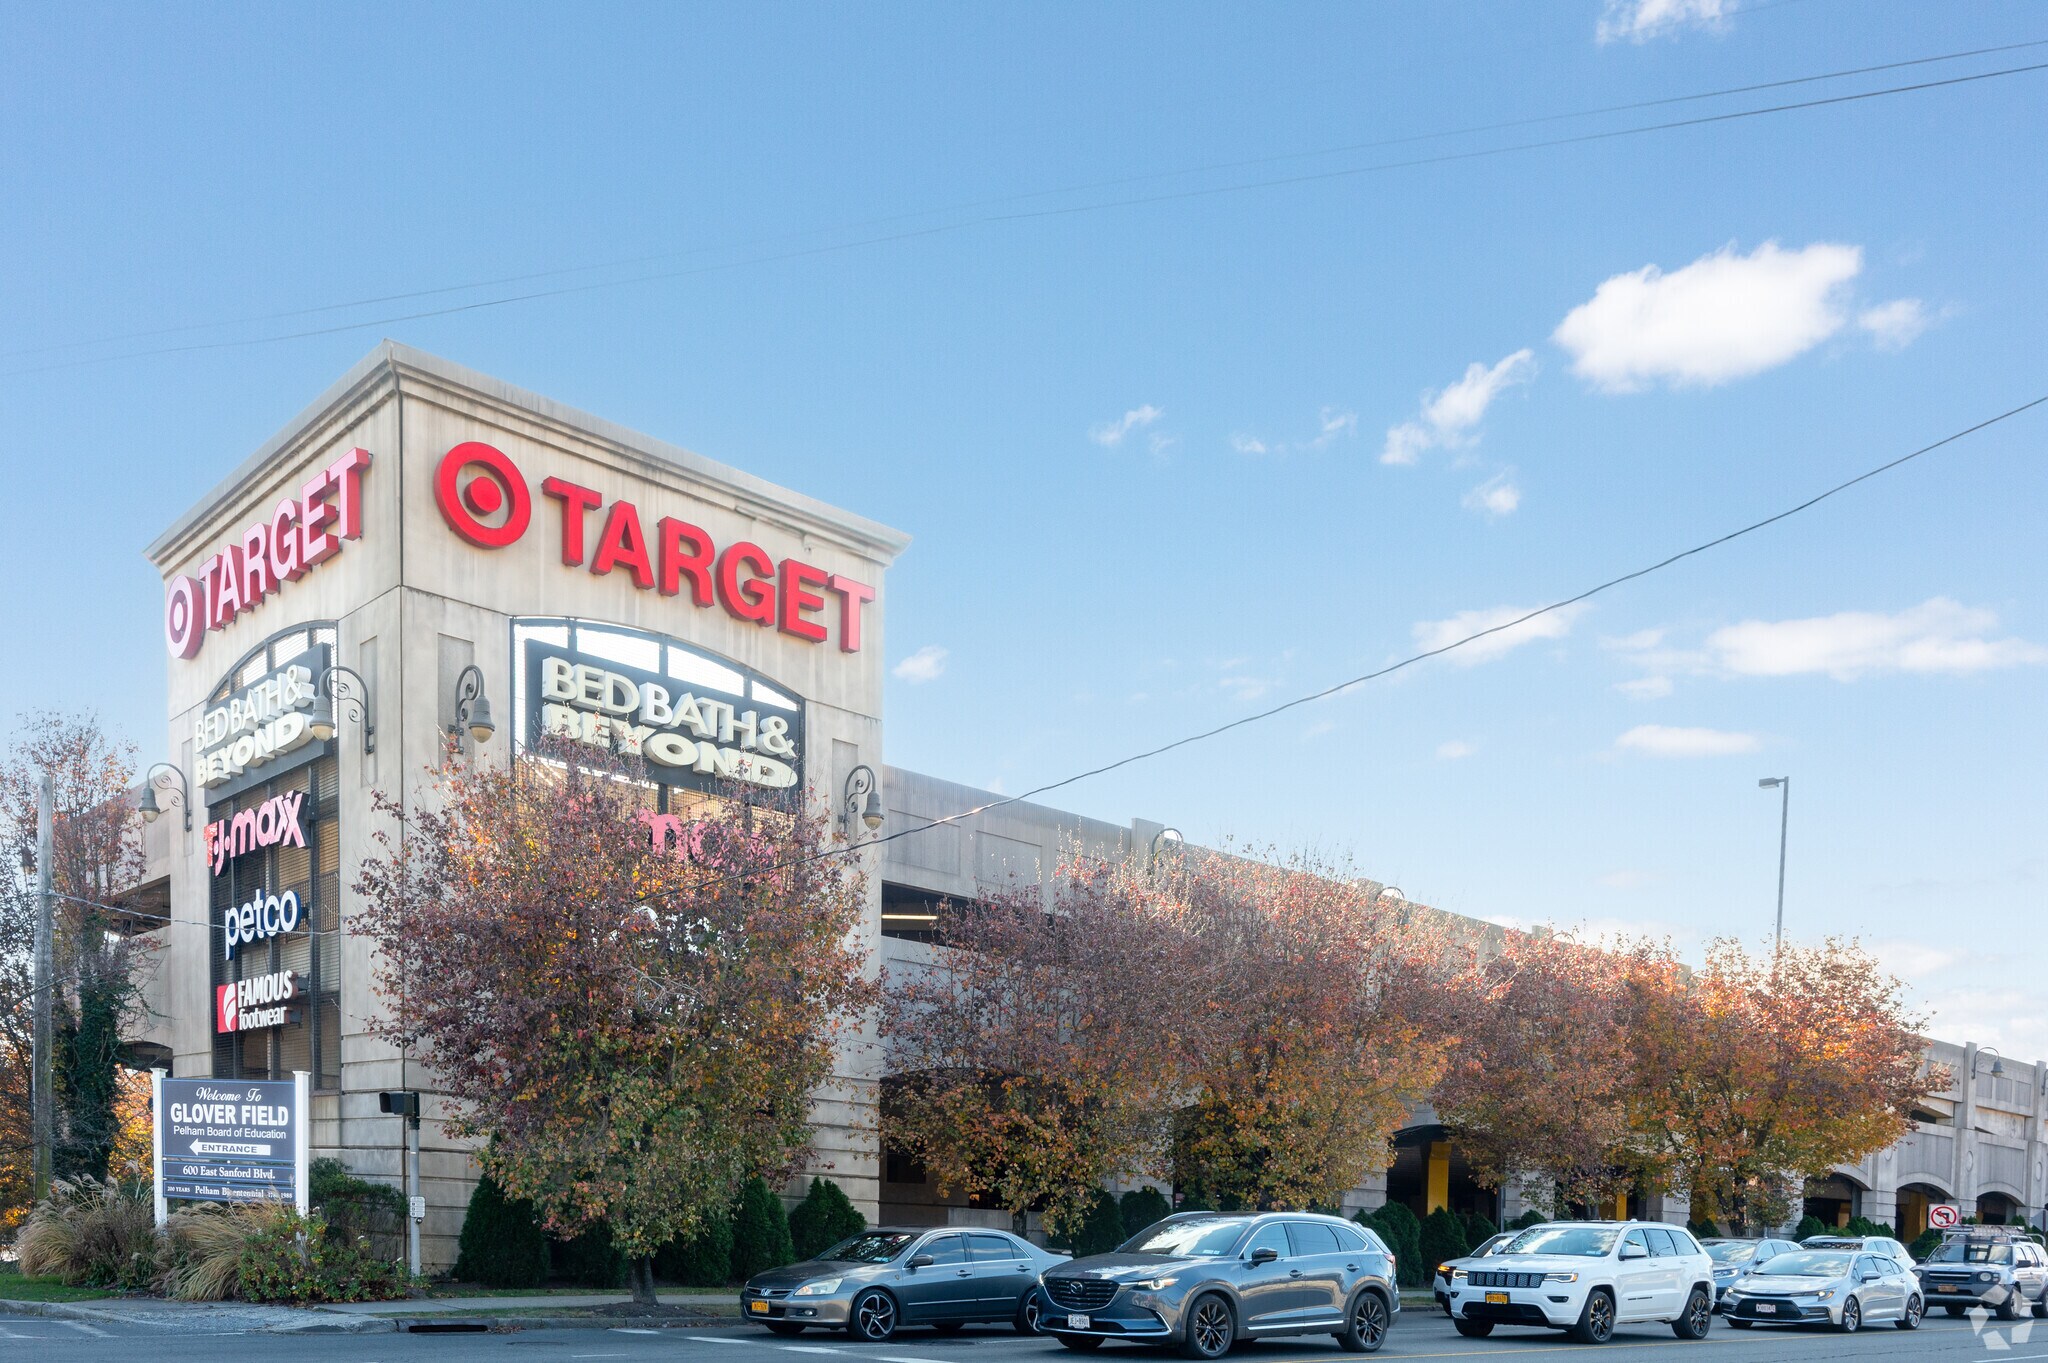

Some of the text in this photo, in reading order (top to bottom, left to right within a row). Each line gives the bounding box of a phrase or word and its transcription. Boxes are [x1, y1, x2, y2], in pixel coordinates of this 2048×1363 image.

[198, 447, 369, 632] TARGET
[542, 476, 876, 654] TARGET
[195, 706, 237, 754] BED
[230, 672, 295, 735] BATH
[542, 656, 797, 759] BED BATH &
[196, 711, 315, 789] BEYOND
[542, 702, 799, 788] BEYOND
[225, 888, 300, 961] petco
[237, 969, 295, 1008] FAMOUS
[238, 1006, 288, 1031] footwear
[196, 1086, 262, 1102] Welcome To
[170, 1103, 289, 1126] GLOVER FIELD
[173, 1125, 287, 1139] Pelham Board of Education
[202, 1144, 258, 1154] ENTRANCE
[182, 1165, 276, 1179] 600 East Sanford Blvd.
[195, 1185, 220, 1195] Pelham
